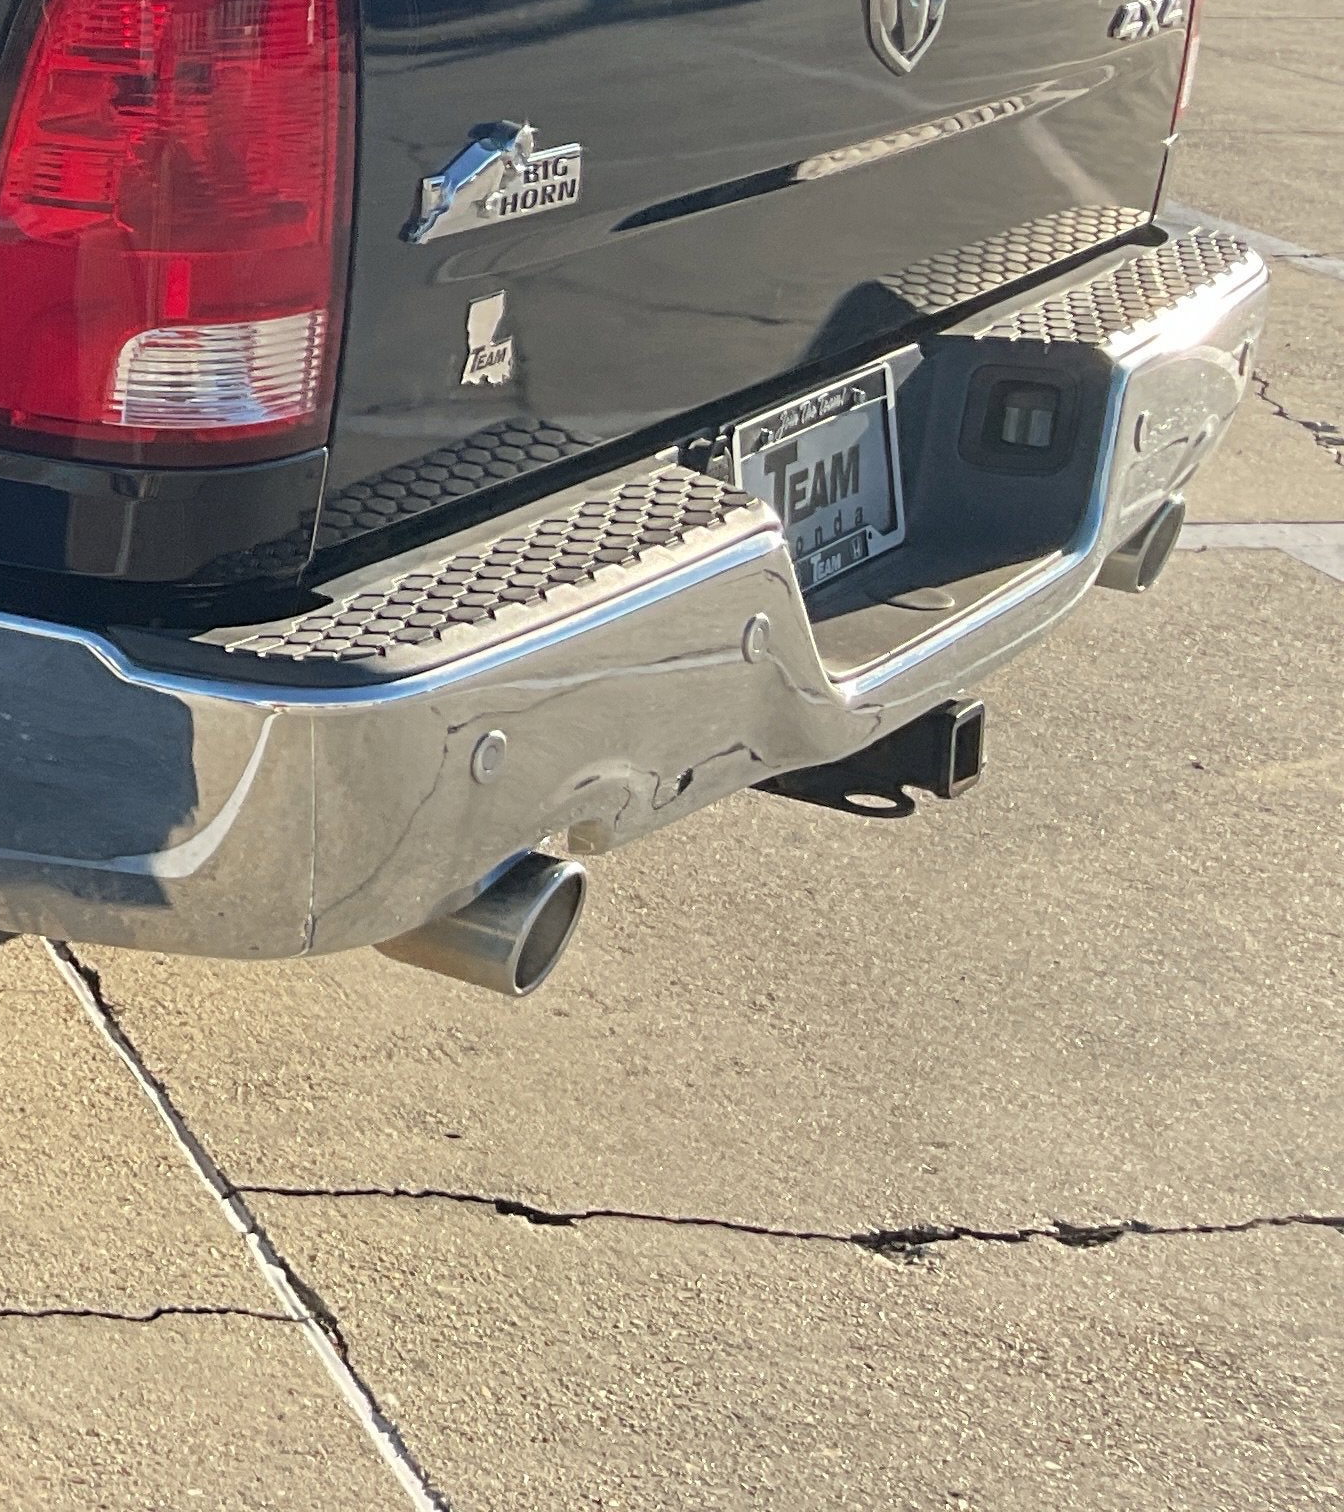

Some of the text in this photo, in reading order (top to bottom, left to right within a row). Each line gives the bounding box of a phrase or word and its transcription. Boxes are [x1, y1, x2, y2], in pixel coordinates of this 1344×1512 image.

[523, 156, 568, 184] BIG
[498, 178, 576, 215] HORN
[469, 345, 507, 373] TEAM
[764, 439, 860, 530] TEAM
[796, 506, 863, 555] onda
[810, 552, 842, 583] TEAM
